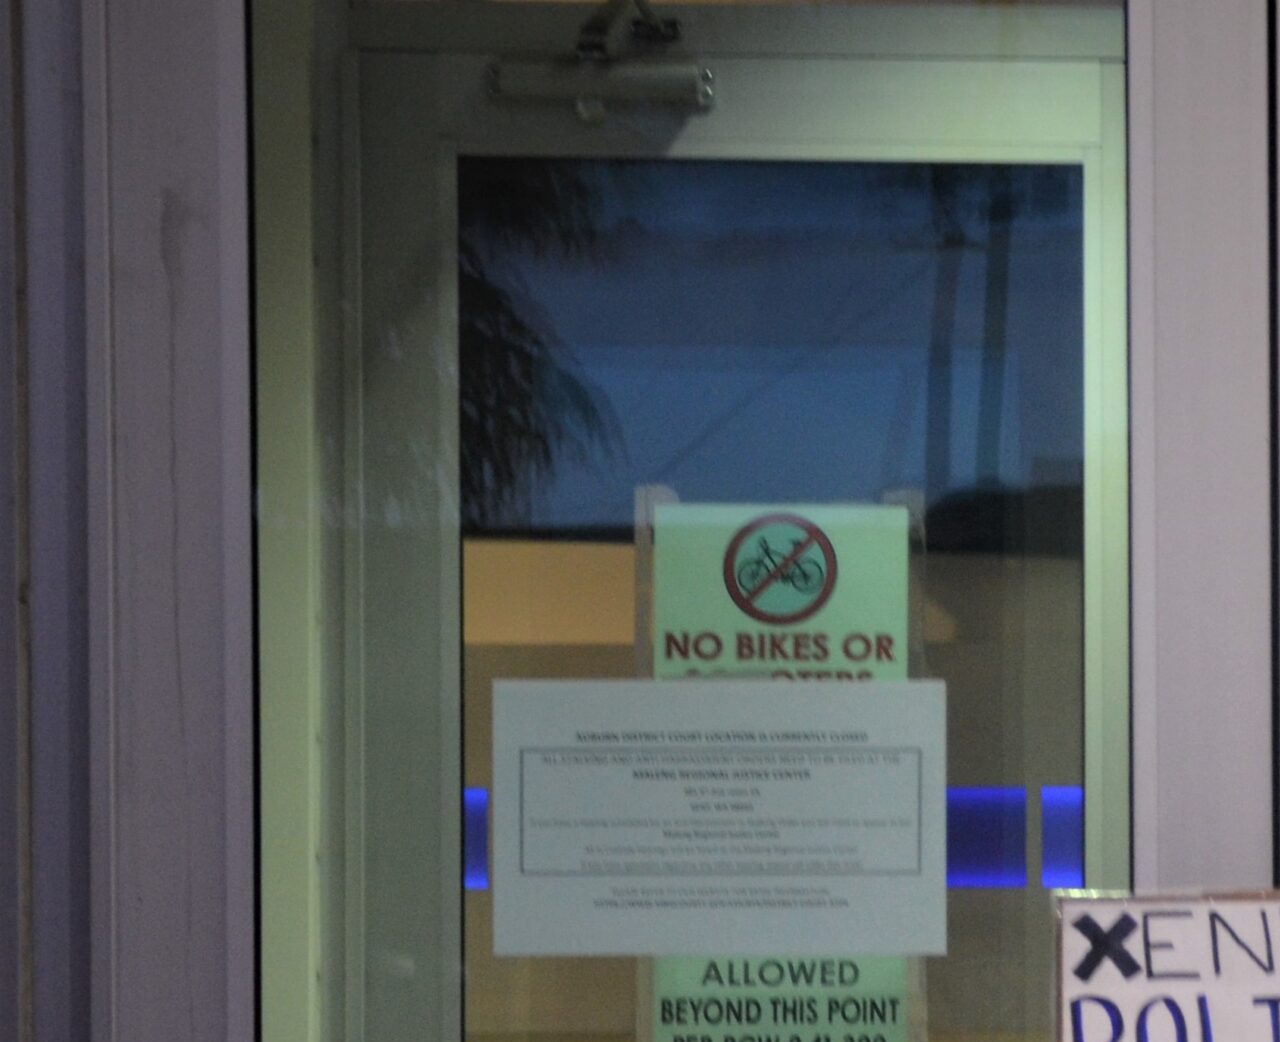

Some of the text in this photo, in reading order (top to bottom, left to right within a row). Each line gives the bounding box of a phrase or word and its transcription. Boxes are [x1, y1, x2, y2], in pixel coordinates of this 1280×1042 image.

[665, 632, 896, 661] NO BIKES OR
[702, 959, 860, 987] ALLOWED
[661, 997, 900, 1025] BEYOND THIS POINT
